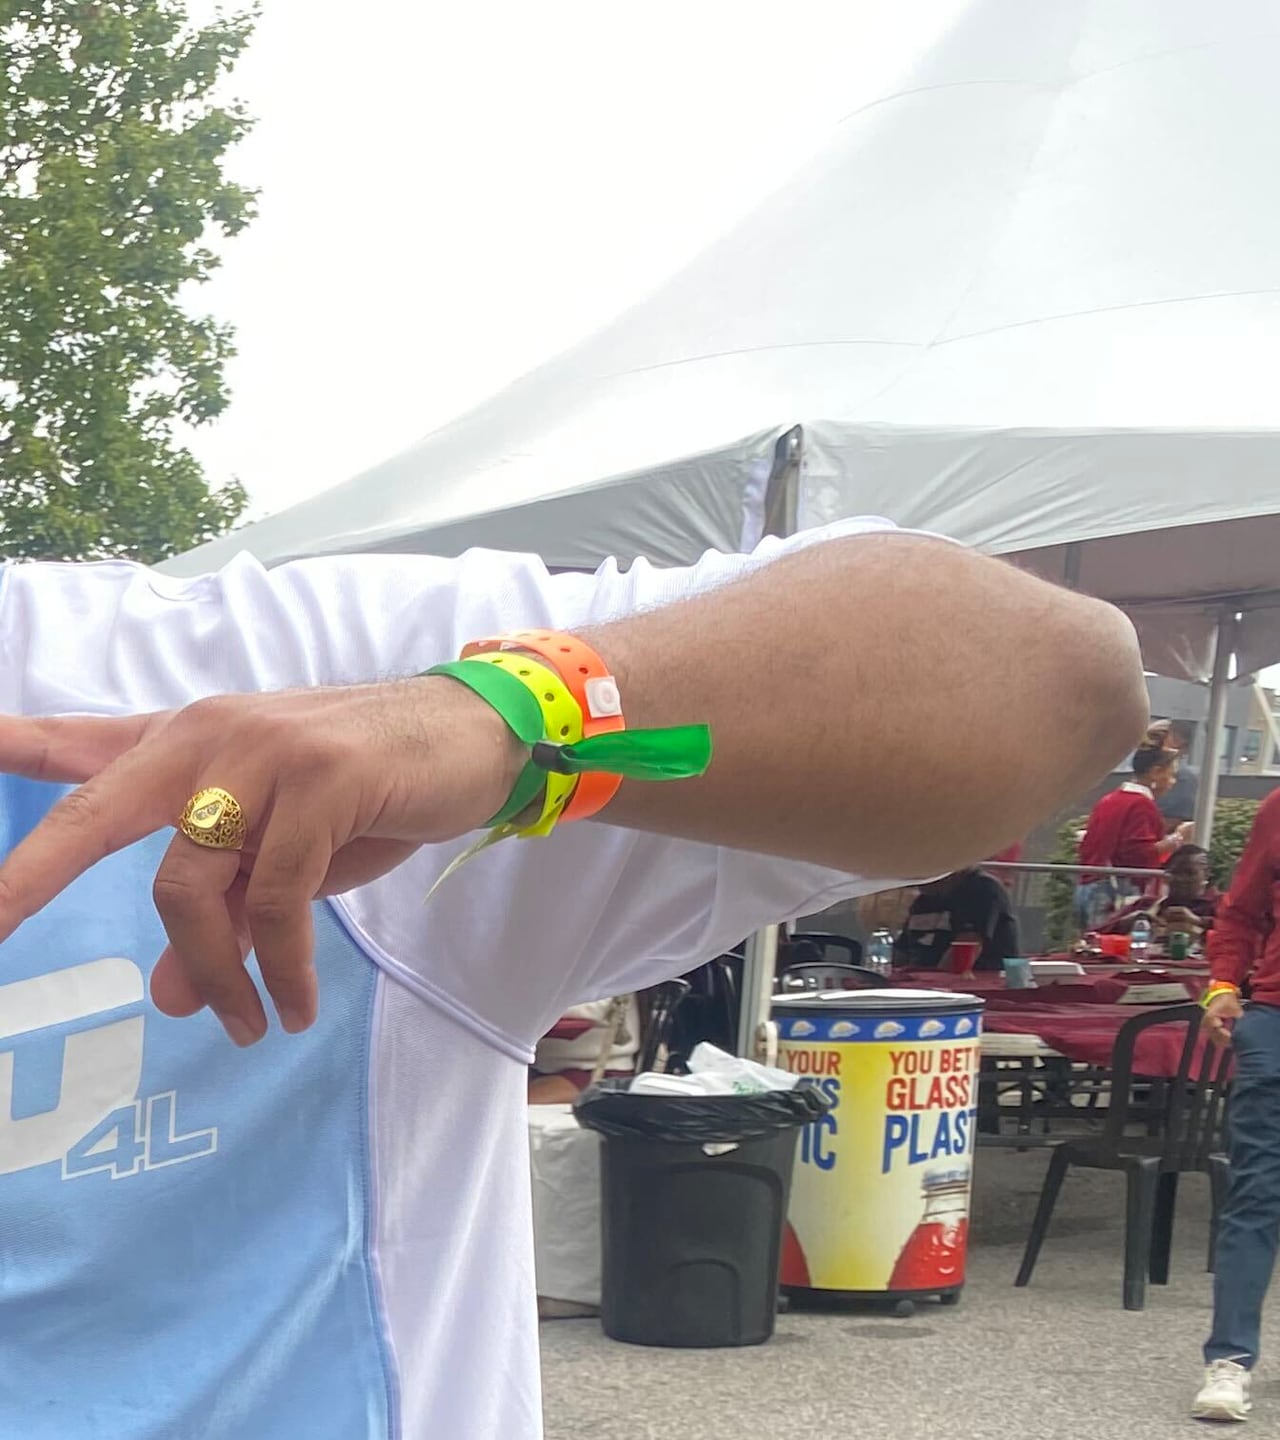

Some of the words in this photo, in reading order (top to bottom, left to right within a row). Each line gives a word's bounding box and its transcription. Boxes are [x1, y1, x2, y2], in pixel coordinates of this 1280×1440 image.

[787, 1050, 842, 1076] YOUR
[888, 1049, 933, 1076] YOU
[939, 1047, 973, 1074] BET
[885, 1073, 970, 1111] GLASS
[61, 1089, 218, 1182] 4L
